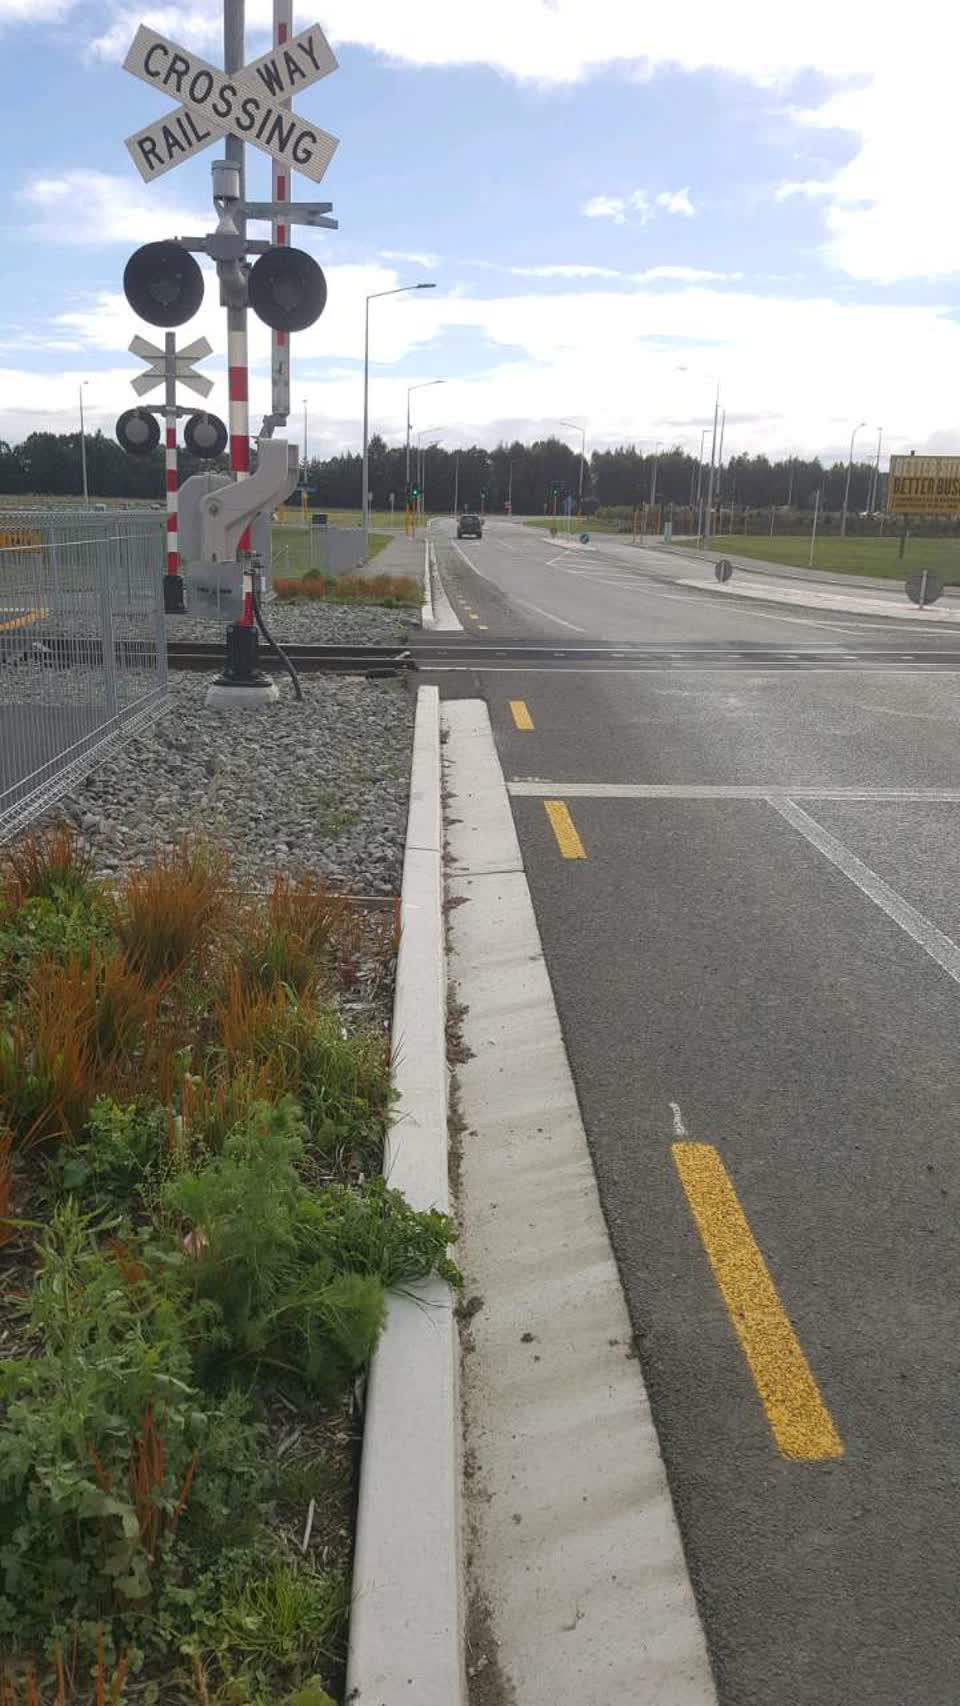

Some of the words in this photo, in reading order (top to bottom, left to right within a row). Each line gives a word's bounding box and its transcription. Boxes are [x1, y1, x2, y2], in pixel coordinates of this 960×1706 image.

[137, 111, 211, 171] RAIL
[256, 35, 321, 97] WAY
[143, 43, 318, 164] CROSSING
[893, 477, 934, 496] BETTER
[936, 477, 960, 496] BUS
